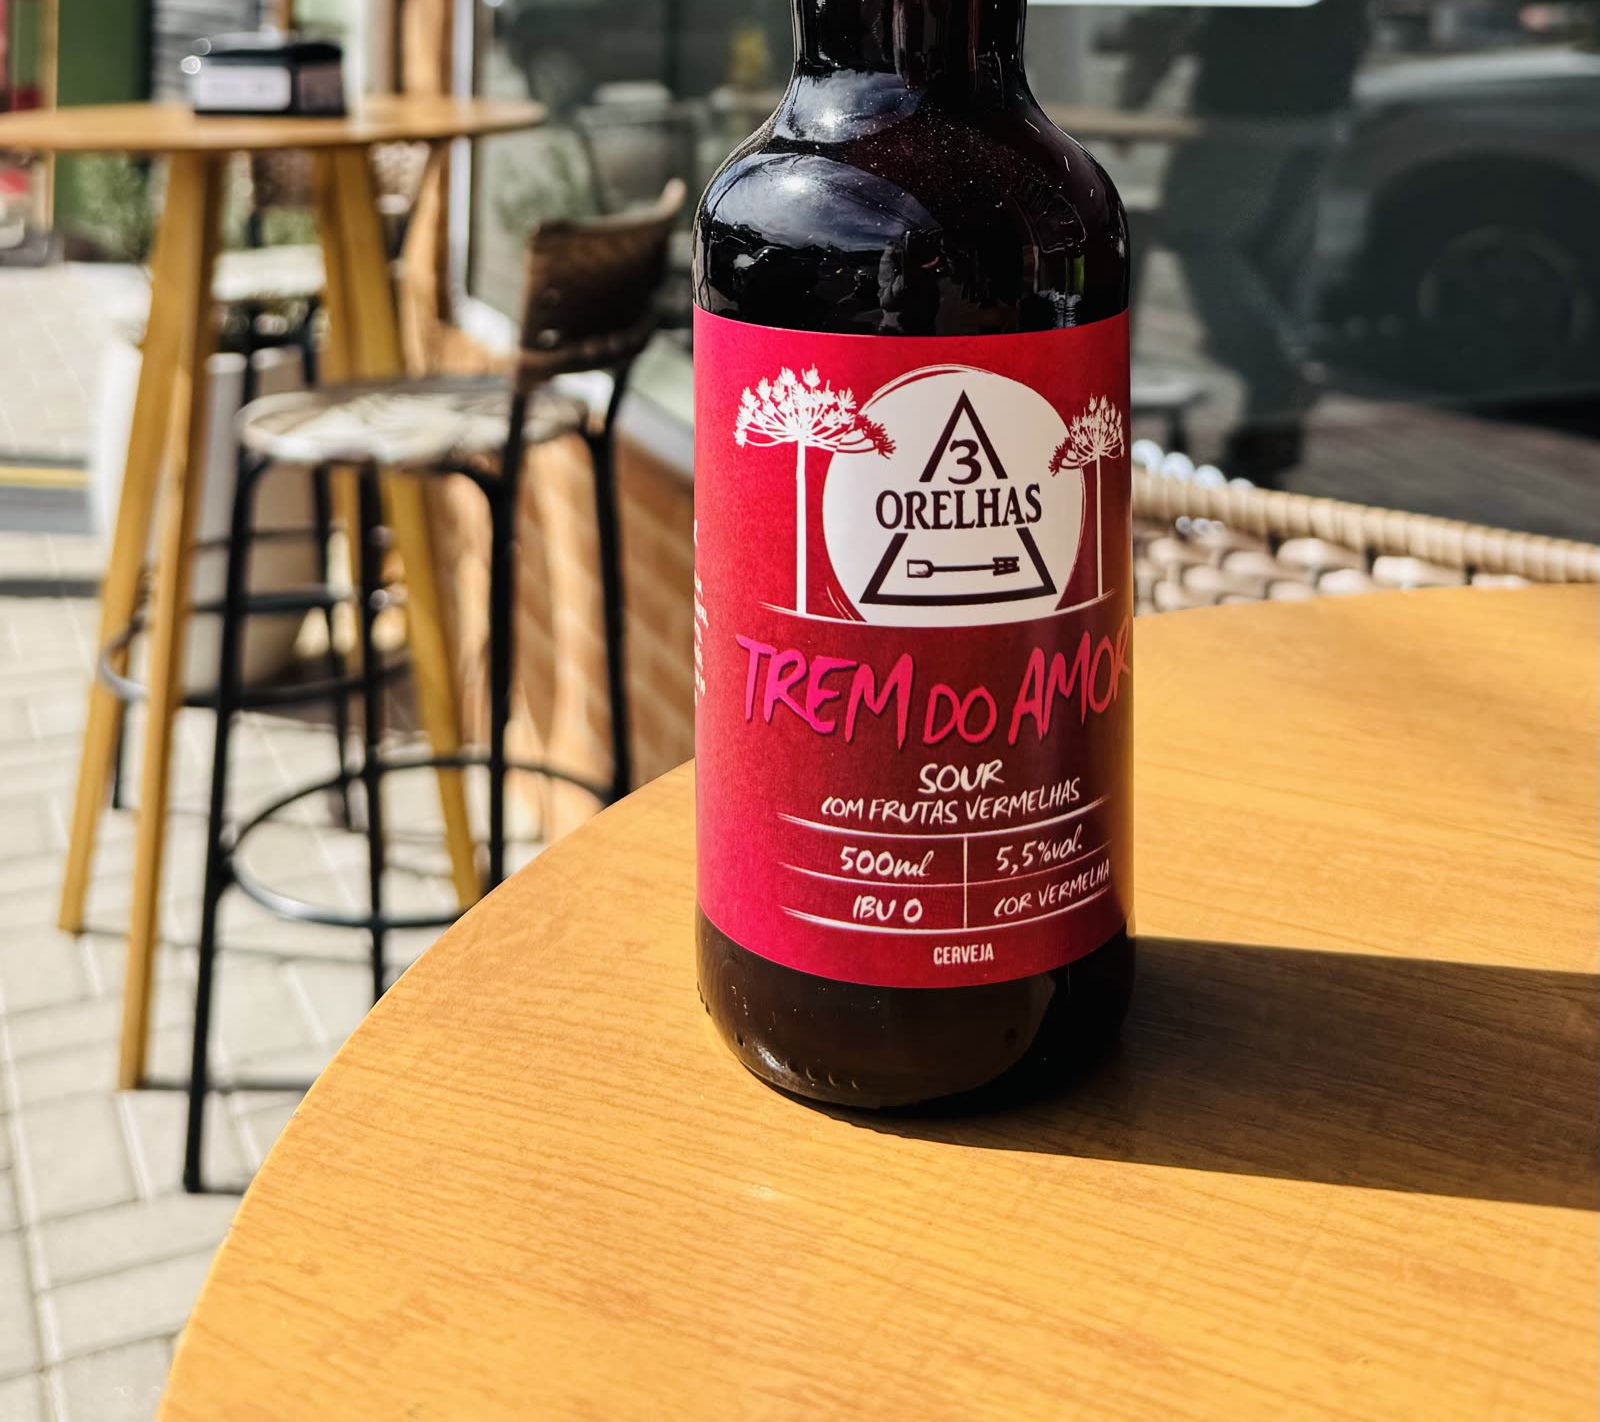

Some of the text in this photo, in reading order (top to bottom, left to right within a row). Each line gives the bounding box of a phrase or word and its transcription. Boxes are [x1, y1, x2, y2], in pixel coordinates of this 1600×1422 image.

[946, 438, 983, 485] 3
[876, 483, 1043, 531] ORELHAS
[735, 634, 915, 749] TREM
[922, 683, 998, 745] DO
[1007, 621, 1131, 747] AMOR
[917, 758, 1006, 795] SOUR
[821, 777, 1081, 825] COM FRUTAS VERMELHAS
[839, 846, 935, 878] 500ml
[852, 894, 897, 922] IBU
[993, 858, 1111, 918] COR VERMELHA
[933, 942, 996, 966] CERVEJA
